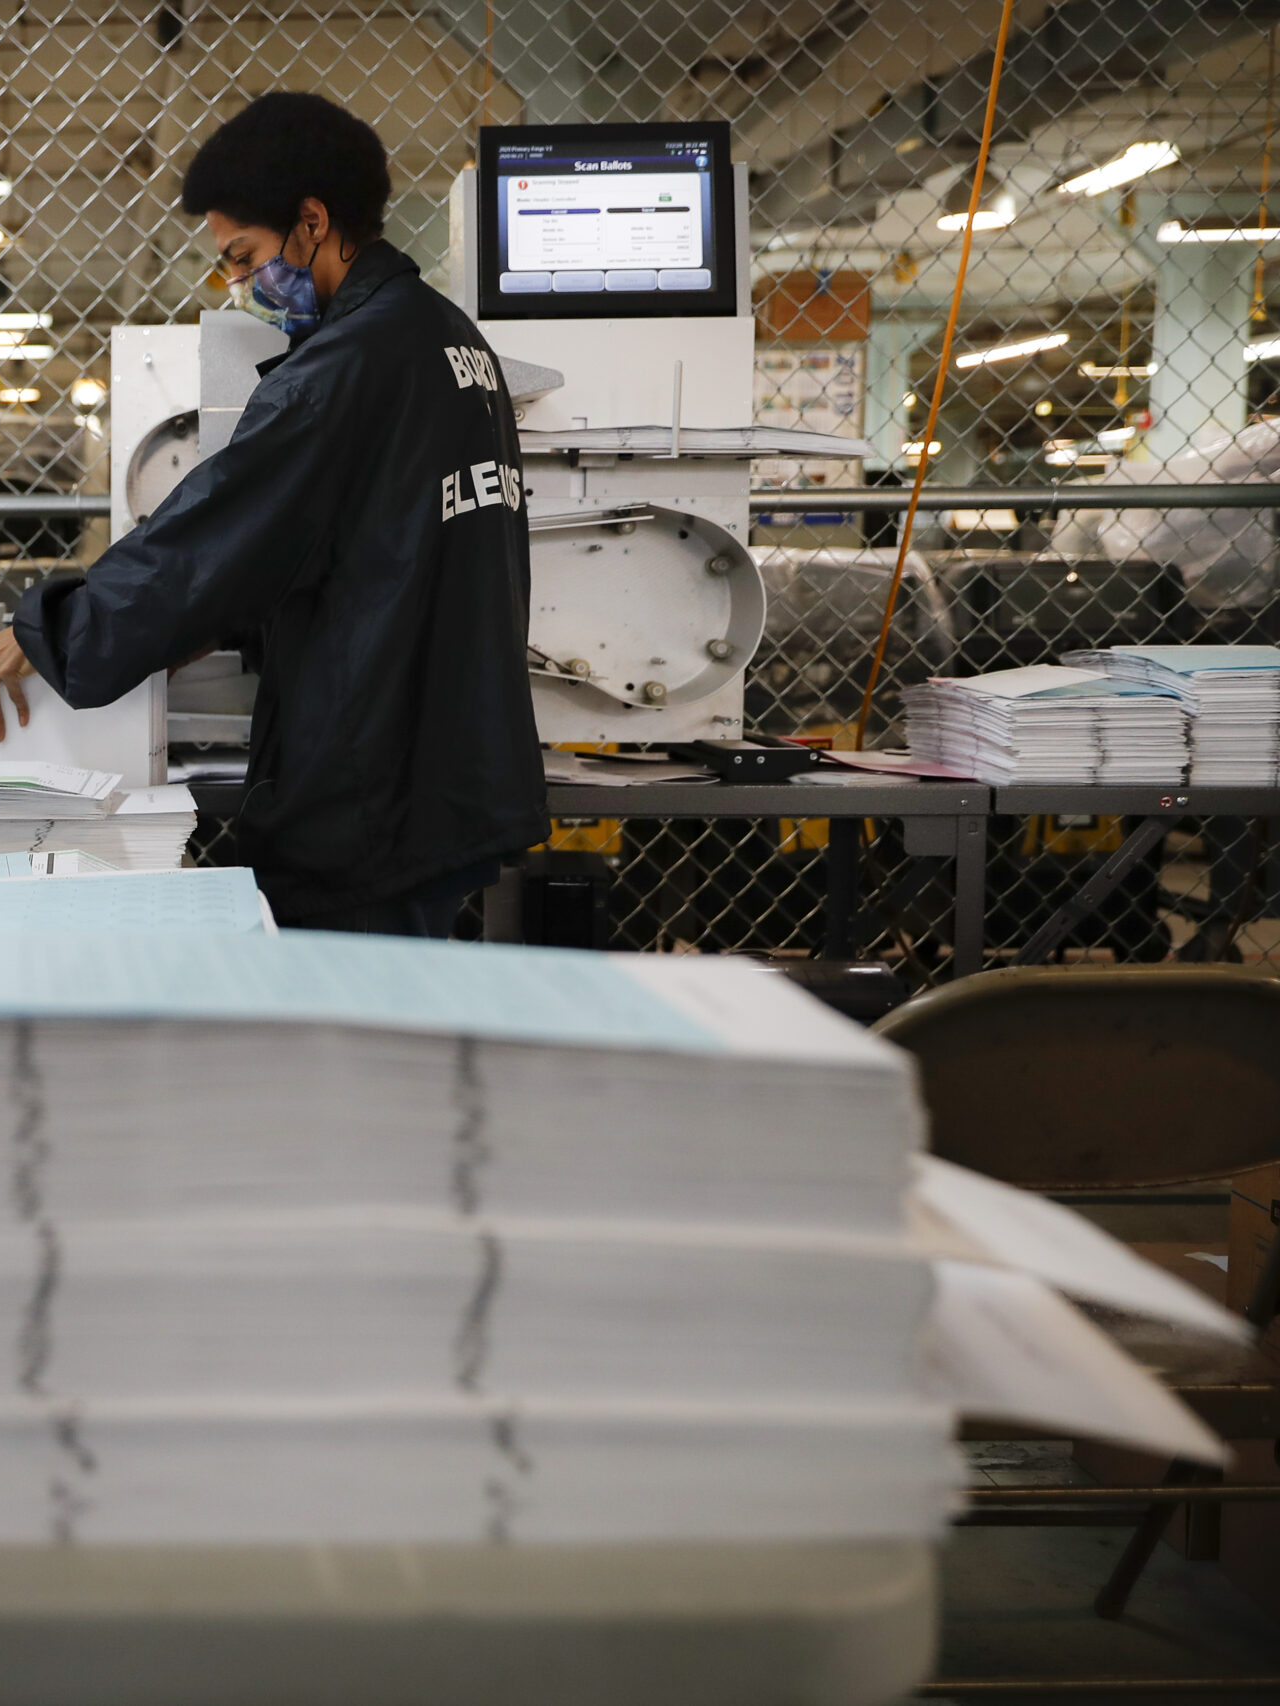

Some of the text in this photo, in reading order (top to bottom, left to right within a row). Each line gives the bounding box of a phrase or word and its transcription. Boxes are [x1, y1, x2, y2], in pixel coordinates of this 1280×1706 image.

[574, 160, 633, 172] Scan Ballots
[443, 345, 498, 391] BORD
